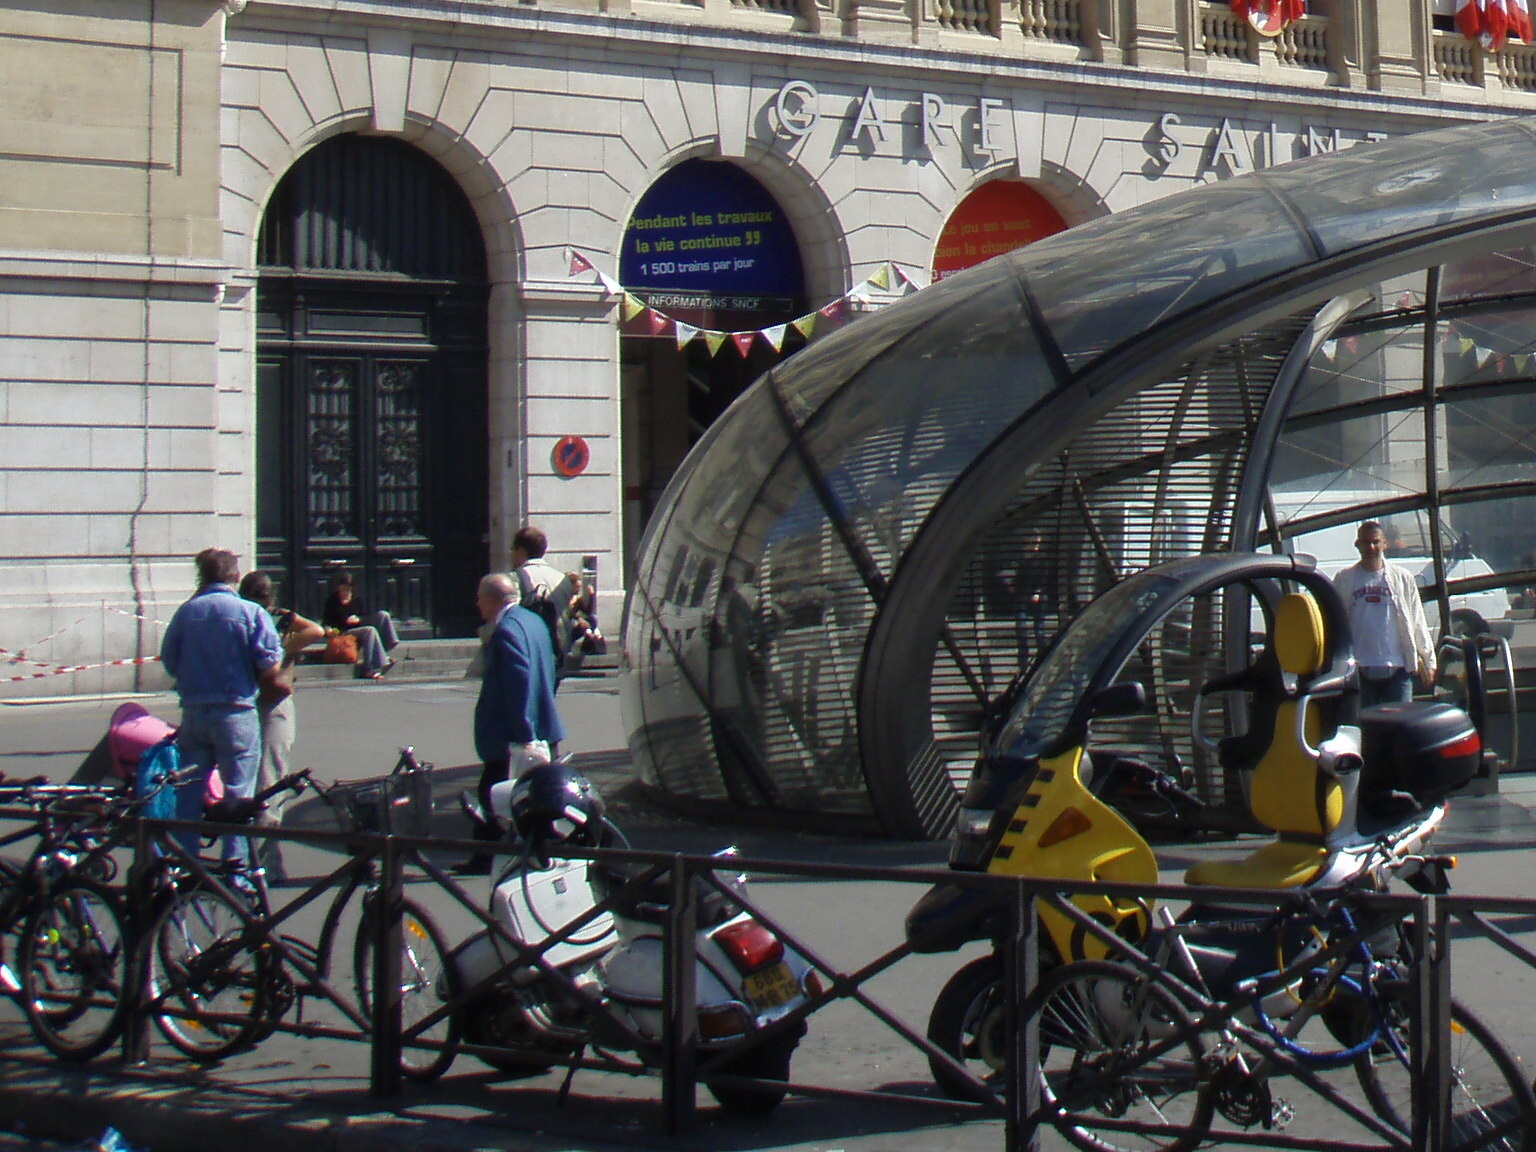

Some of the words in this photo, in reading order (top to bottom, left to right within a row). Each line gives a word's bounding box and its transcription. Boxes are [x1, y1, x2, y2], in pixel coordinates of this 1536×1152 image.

[776, 79, 1003, 151] GARE
[627, 212, 687, 230] Pendant
[691, 211, 712, 226] les
[718, 210, 773, 224] travaux
[636, 239, 649, 253] la
[654, 237, 675, 252] vie
[679, 233, 742, 250] continue
[651, 261, 675, 275] 500
[677, 259, 710, 273] trains
[713, 259, 732, 272] par
[733, 258, 755, 272] jour
[648, 295, 728, 309] INFORMATIONS
[732, 298, 761, 309] SNCF
